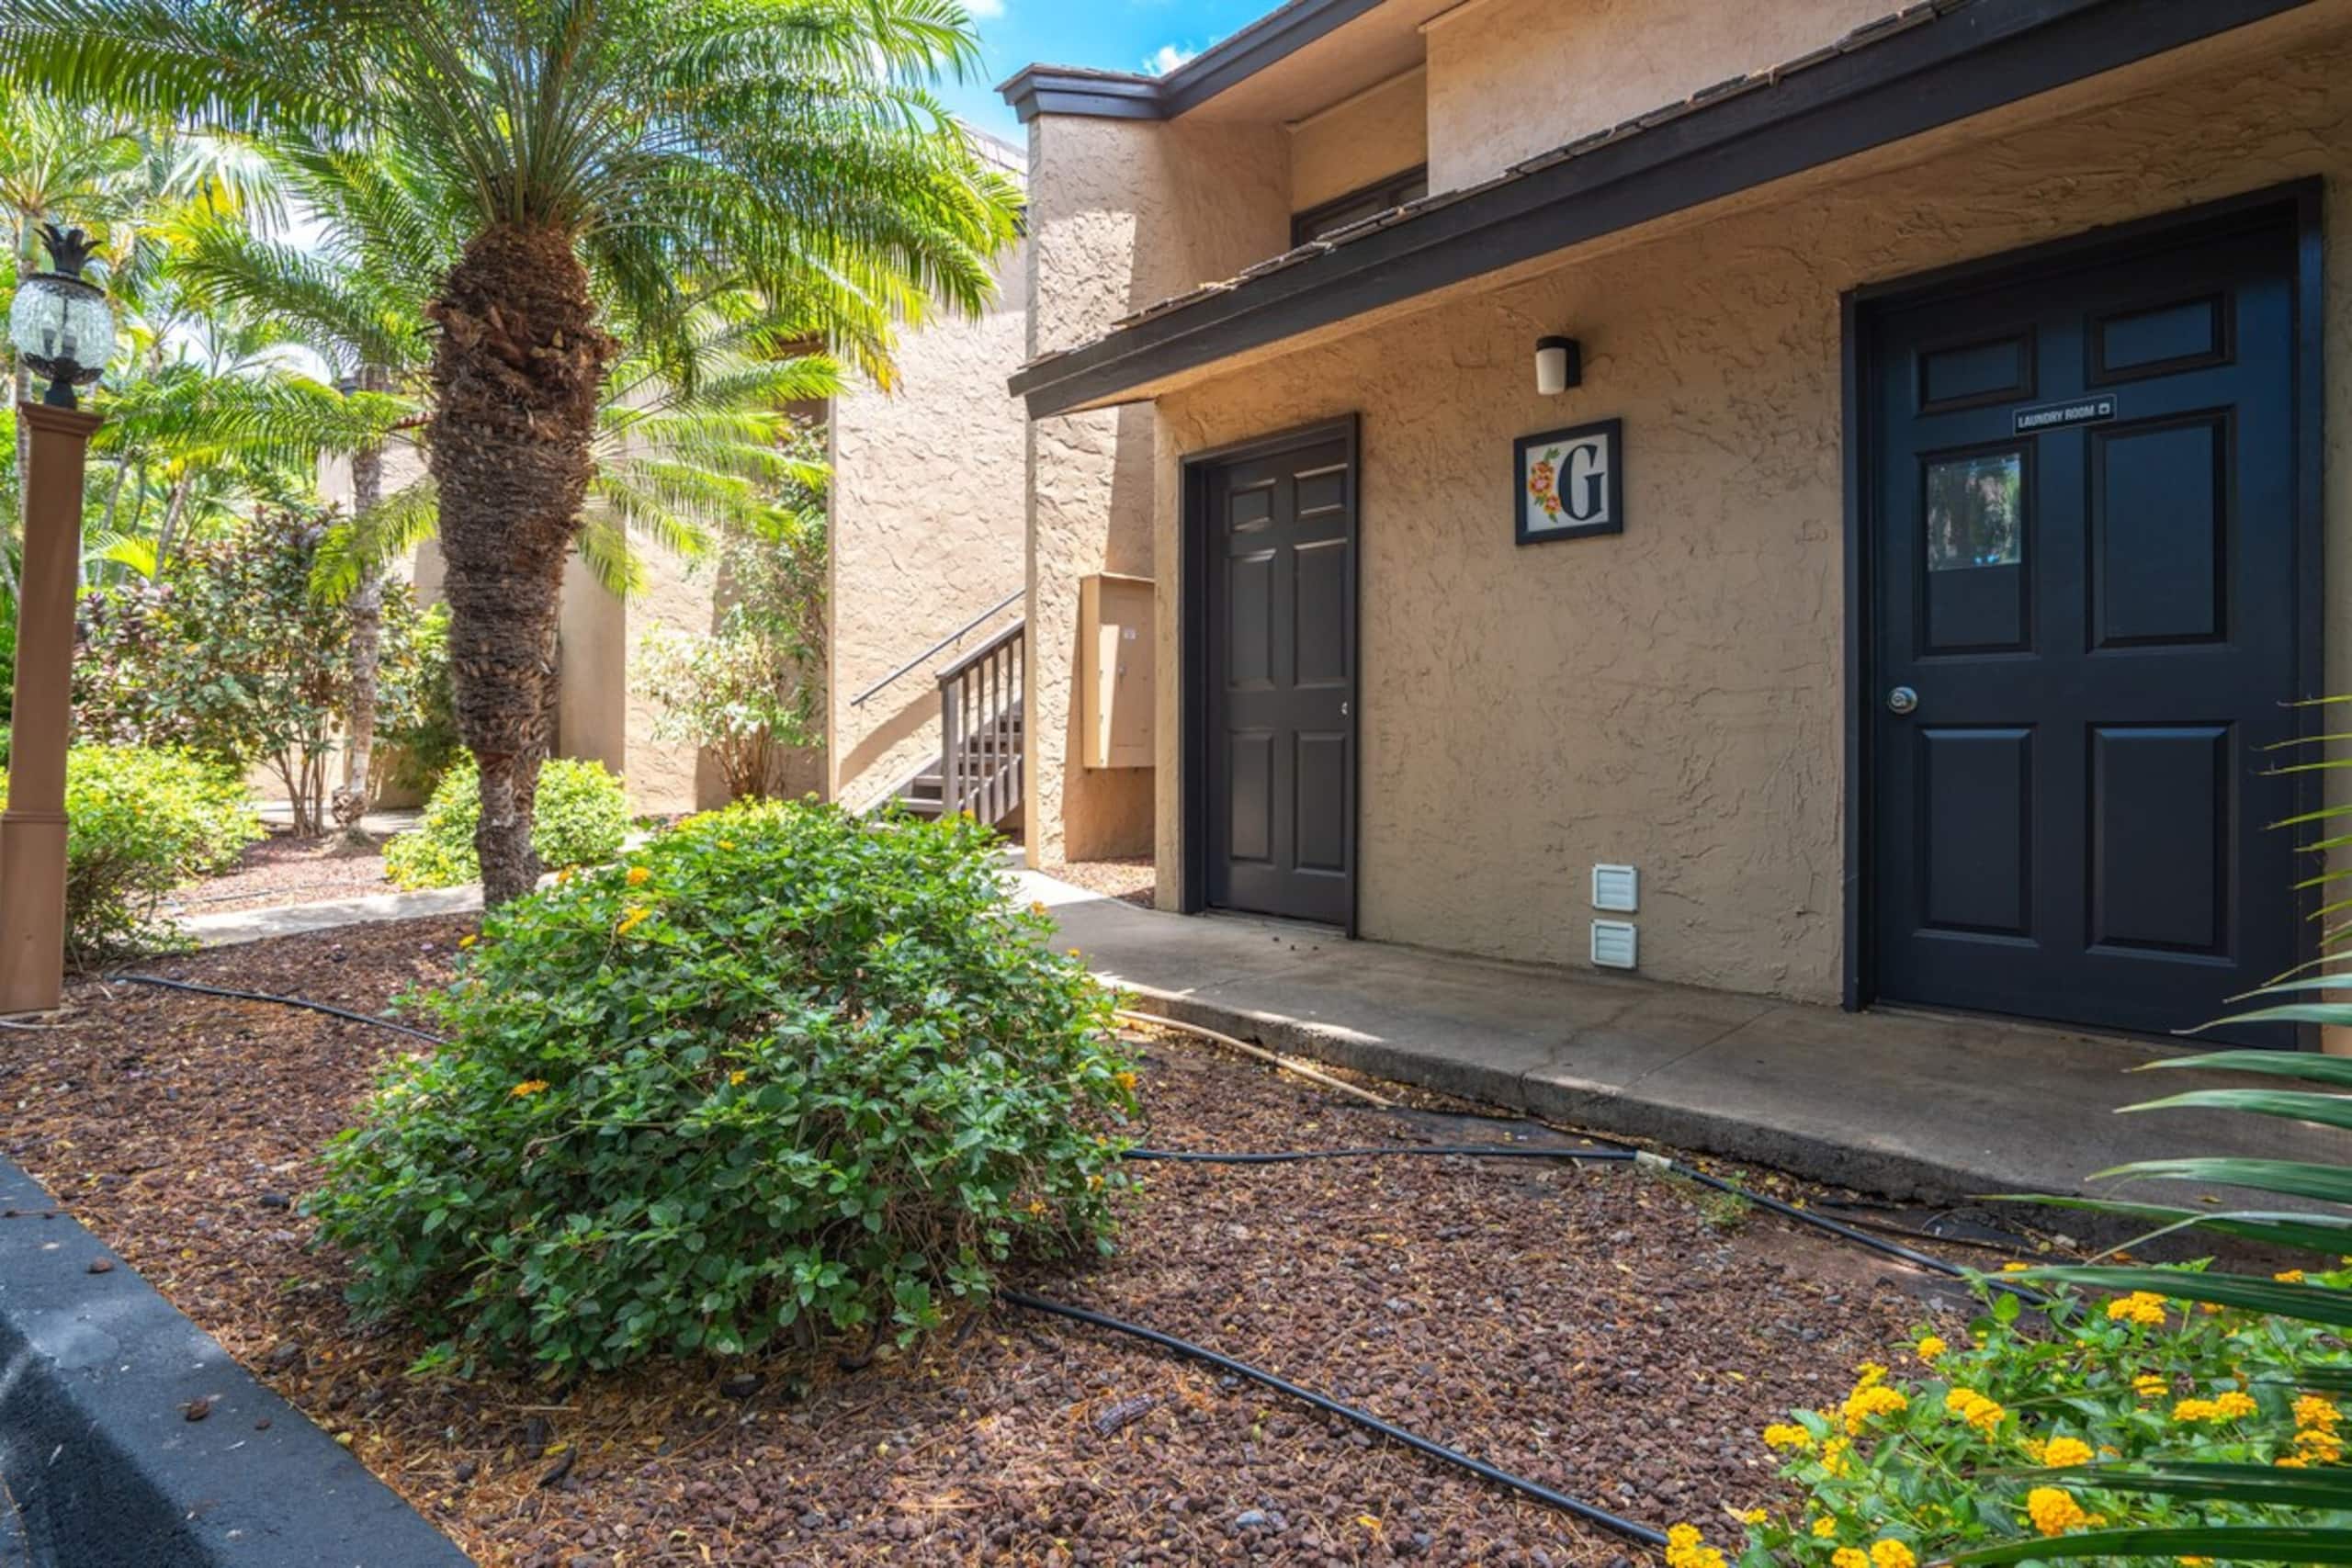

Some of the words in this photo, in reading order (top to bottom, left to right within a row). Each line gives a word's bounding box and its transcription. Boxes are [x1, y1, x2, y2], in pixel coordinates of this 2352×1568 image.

[2018, 410, 2064, 428] LAUNDRY
[2064, 404, 2095, 420] ROOM
[1558, 444, 1605, 521] G
